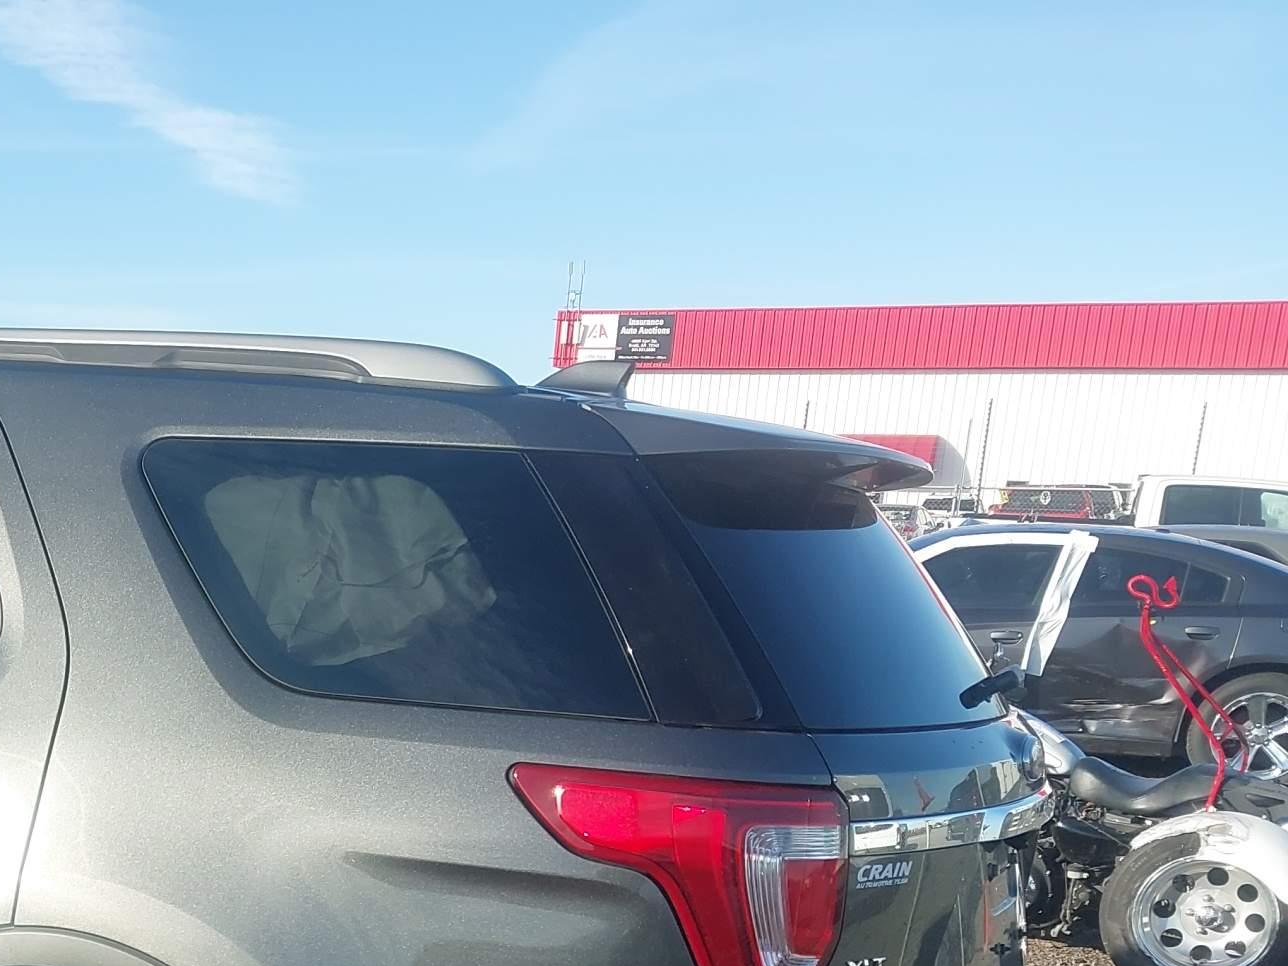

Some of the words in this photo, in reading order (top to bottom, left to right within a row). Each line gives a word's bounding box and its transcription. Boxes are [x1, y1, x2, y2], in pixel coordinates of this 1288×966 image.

[628, 318, 665, 326] Insurance
[620, 326, 637, 335] Auto
[638, 326, 671, 335] Auctions
[857, 861, 913, 882] CRAIN
[856, 879, 893, 889] AUTOMOTIVE
